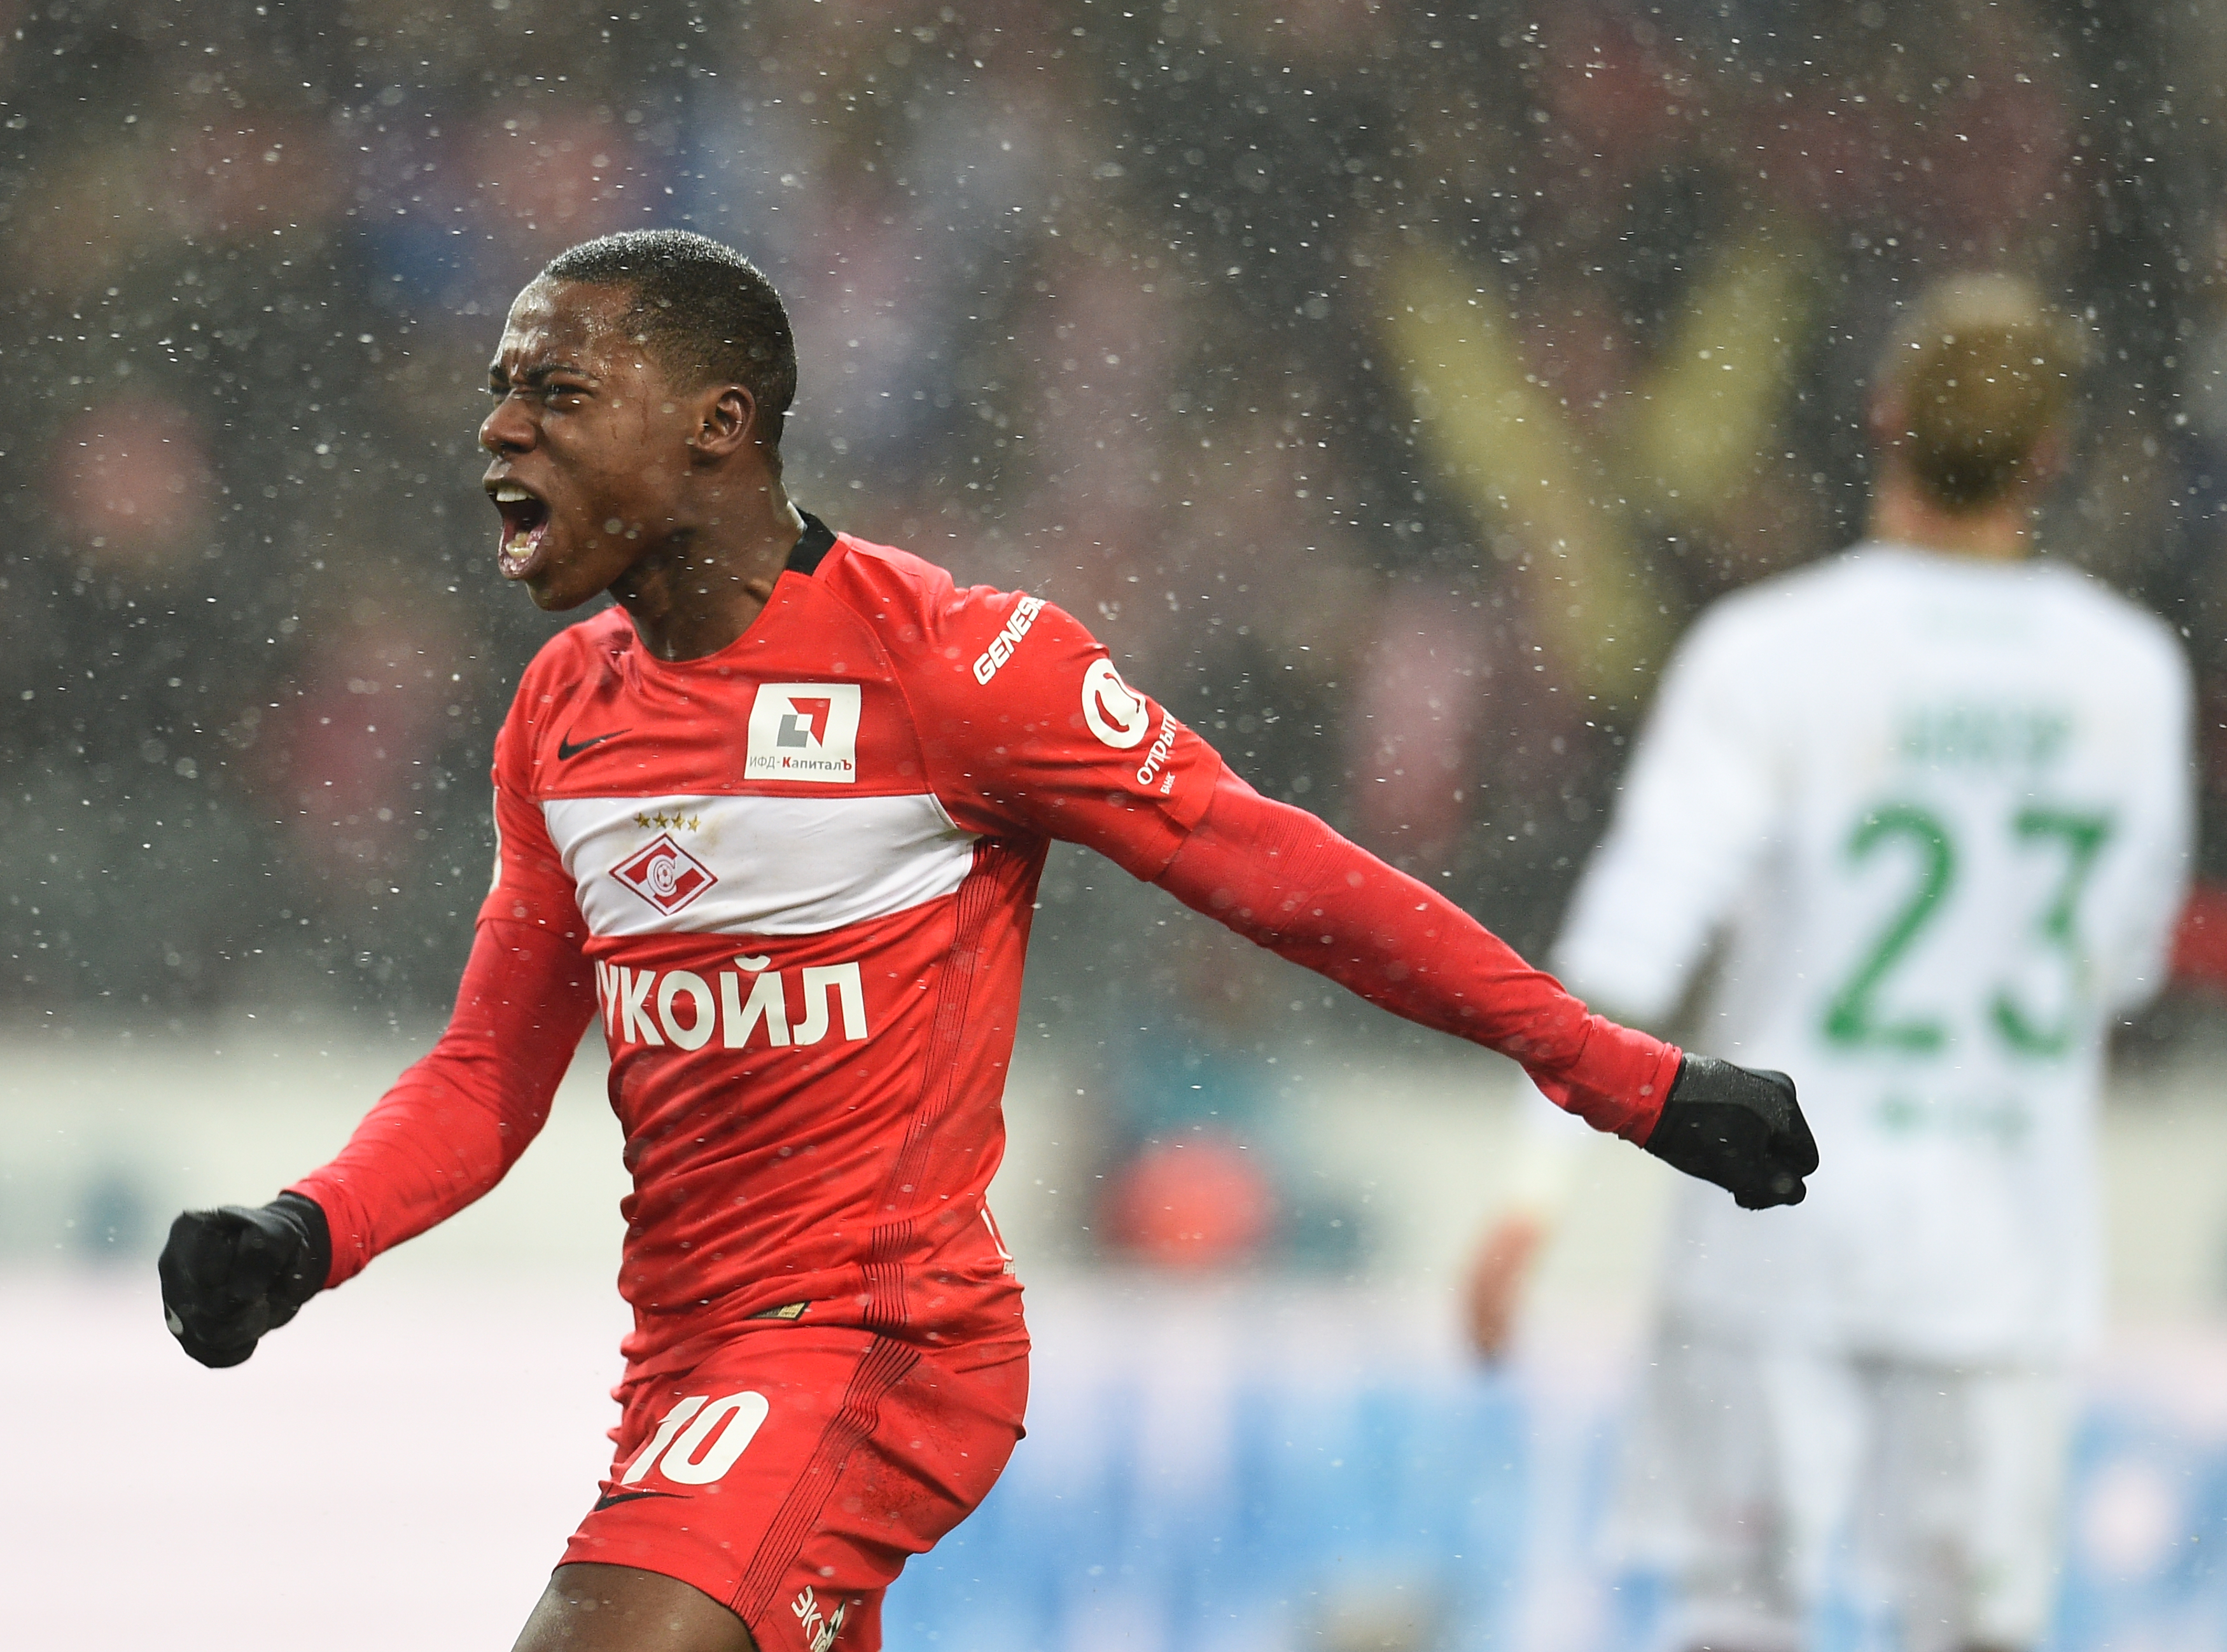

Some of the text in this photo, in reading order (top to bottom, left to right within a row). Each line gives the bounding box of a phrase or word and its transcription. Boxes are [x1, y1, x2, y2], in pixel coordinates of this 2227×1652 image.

[1822, 803, 2116, 1057] 23
[594, 954, 868, 1052] УКОЙЛ
[620, 1391, 770, 1485] 10
